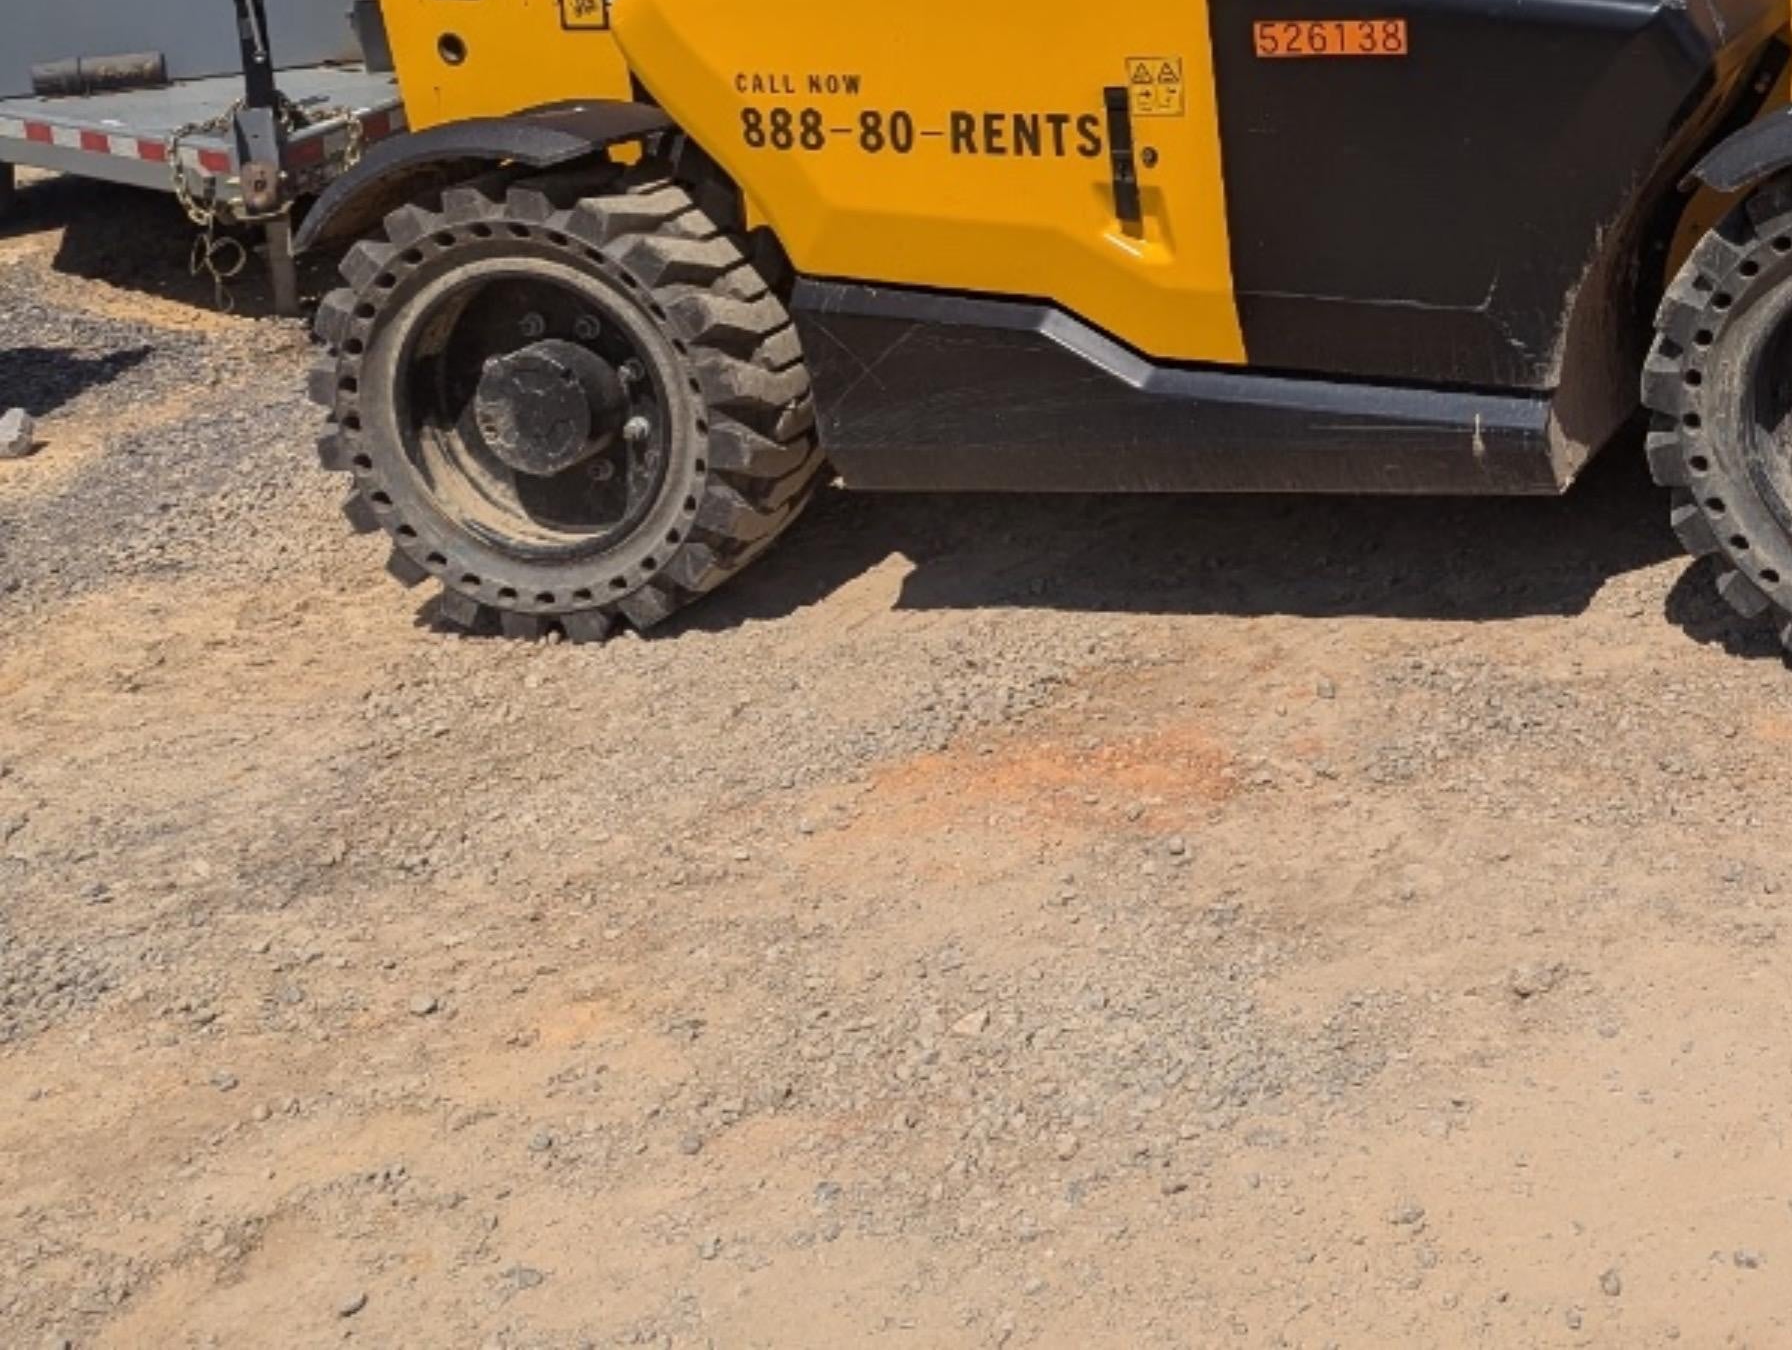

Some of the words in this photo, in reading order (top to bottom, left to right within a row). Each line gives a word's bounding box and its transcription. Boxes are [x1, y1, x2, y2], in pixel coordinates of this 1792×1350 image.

[1259, 21, 1403, 55] 526138
[735, 74, 796, 94] CALL
[808, 75, 861, 95] NOW
[740, 107, 1103, 157] 888-80-RENTS
